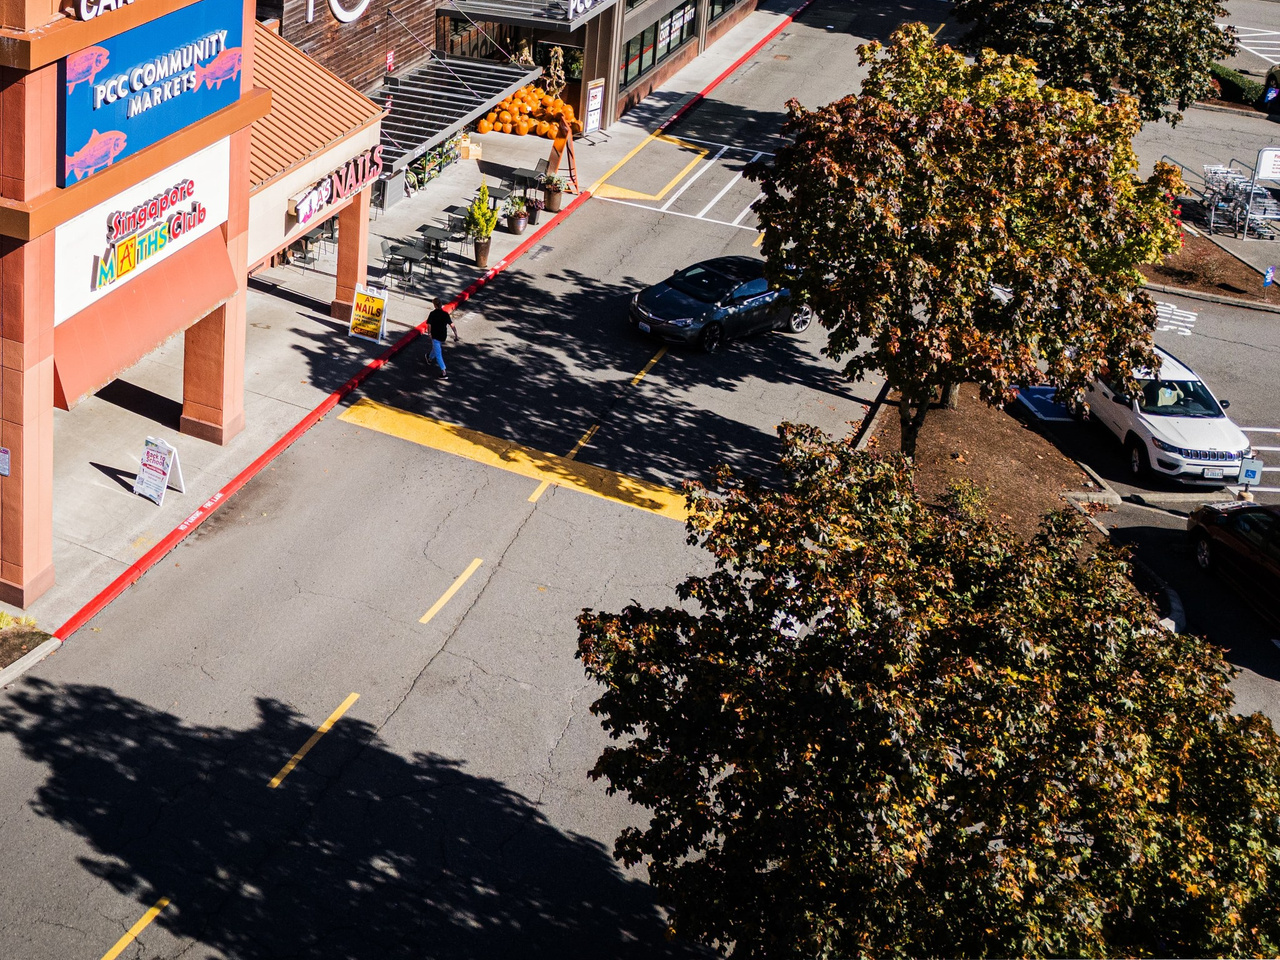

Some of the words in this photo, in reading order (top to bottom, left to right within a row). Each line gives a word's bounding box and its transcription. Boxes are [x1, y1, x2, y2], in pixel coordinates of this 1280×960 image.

[93, 74, 128, 111] PCC
[130, 30, 228, 91] COMMUNITY
[127, 71, 197, 119] MARKETS
[329, 145, 384, 204] NAILS
[110, 179, 195, 240] Singapore
[97, 222, 169, 289] MATHS
[170, 202, 207, 240] Club
[355, 302, 381, 318] NAILS
[146, 456, 165, 467] School
